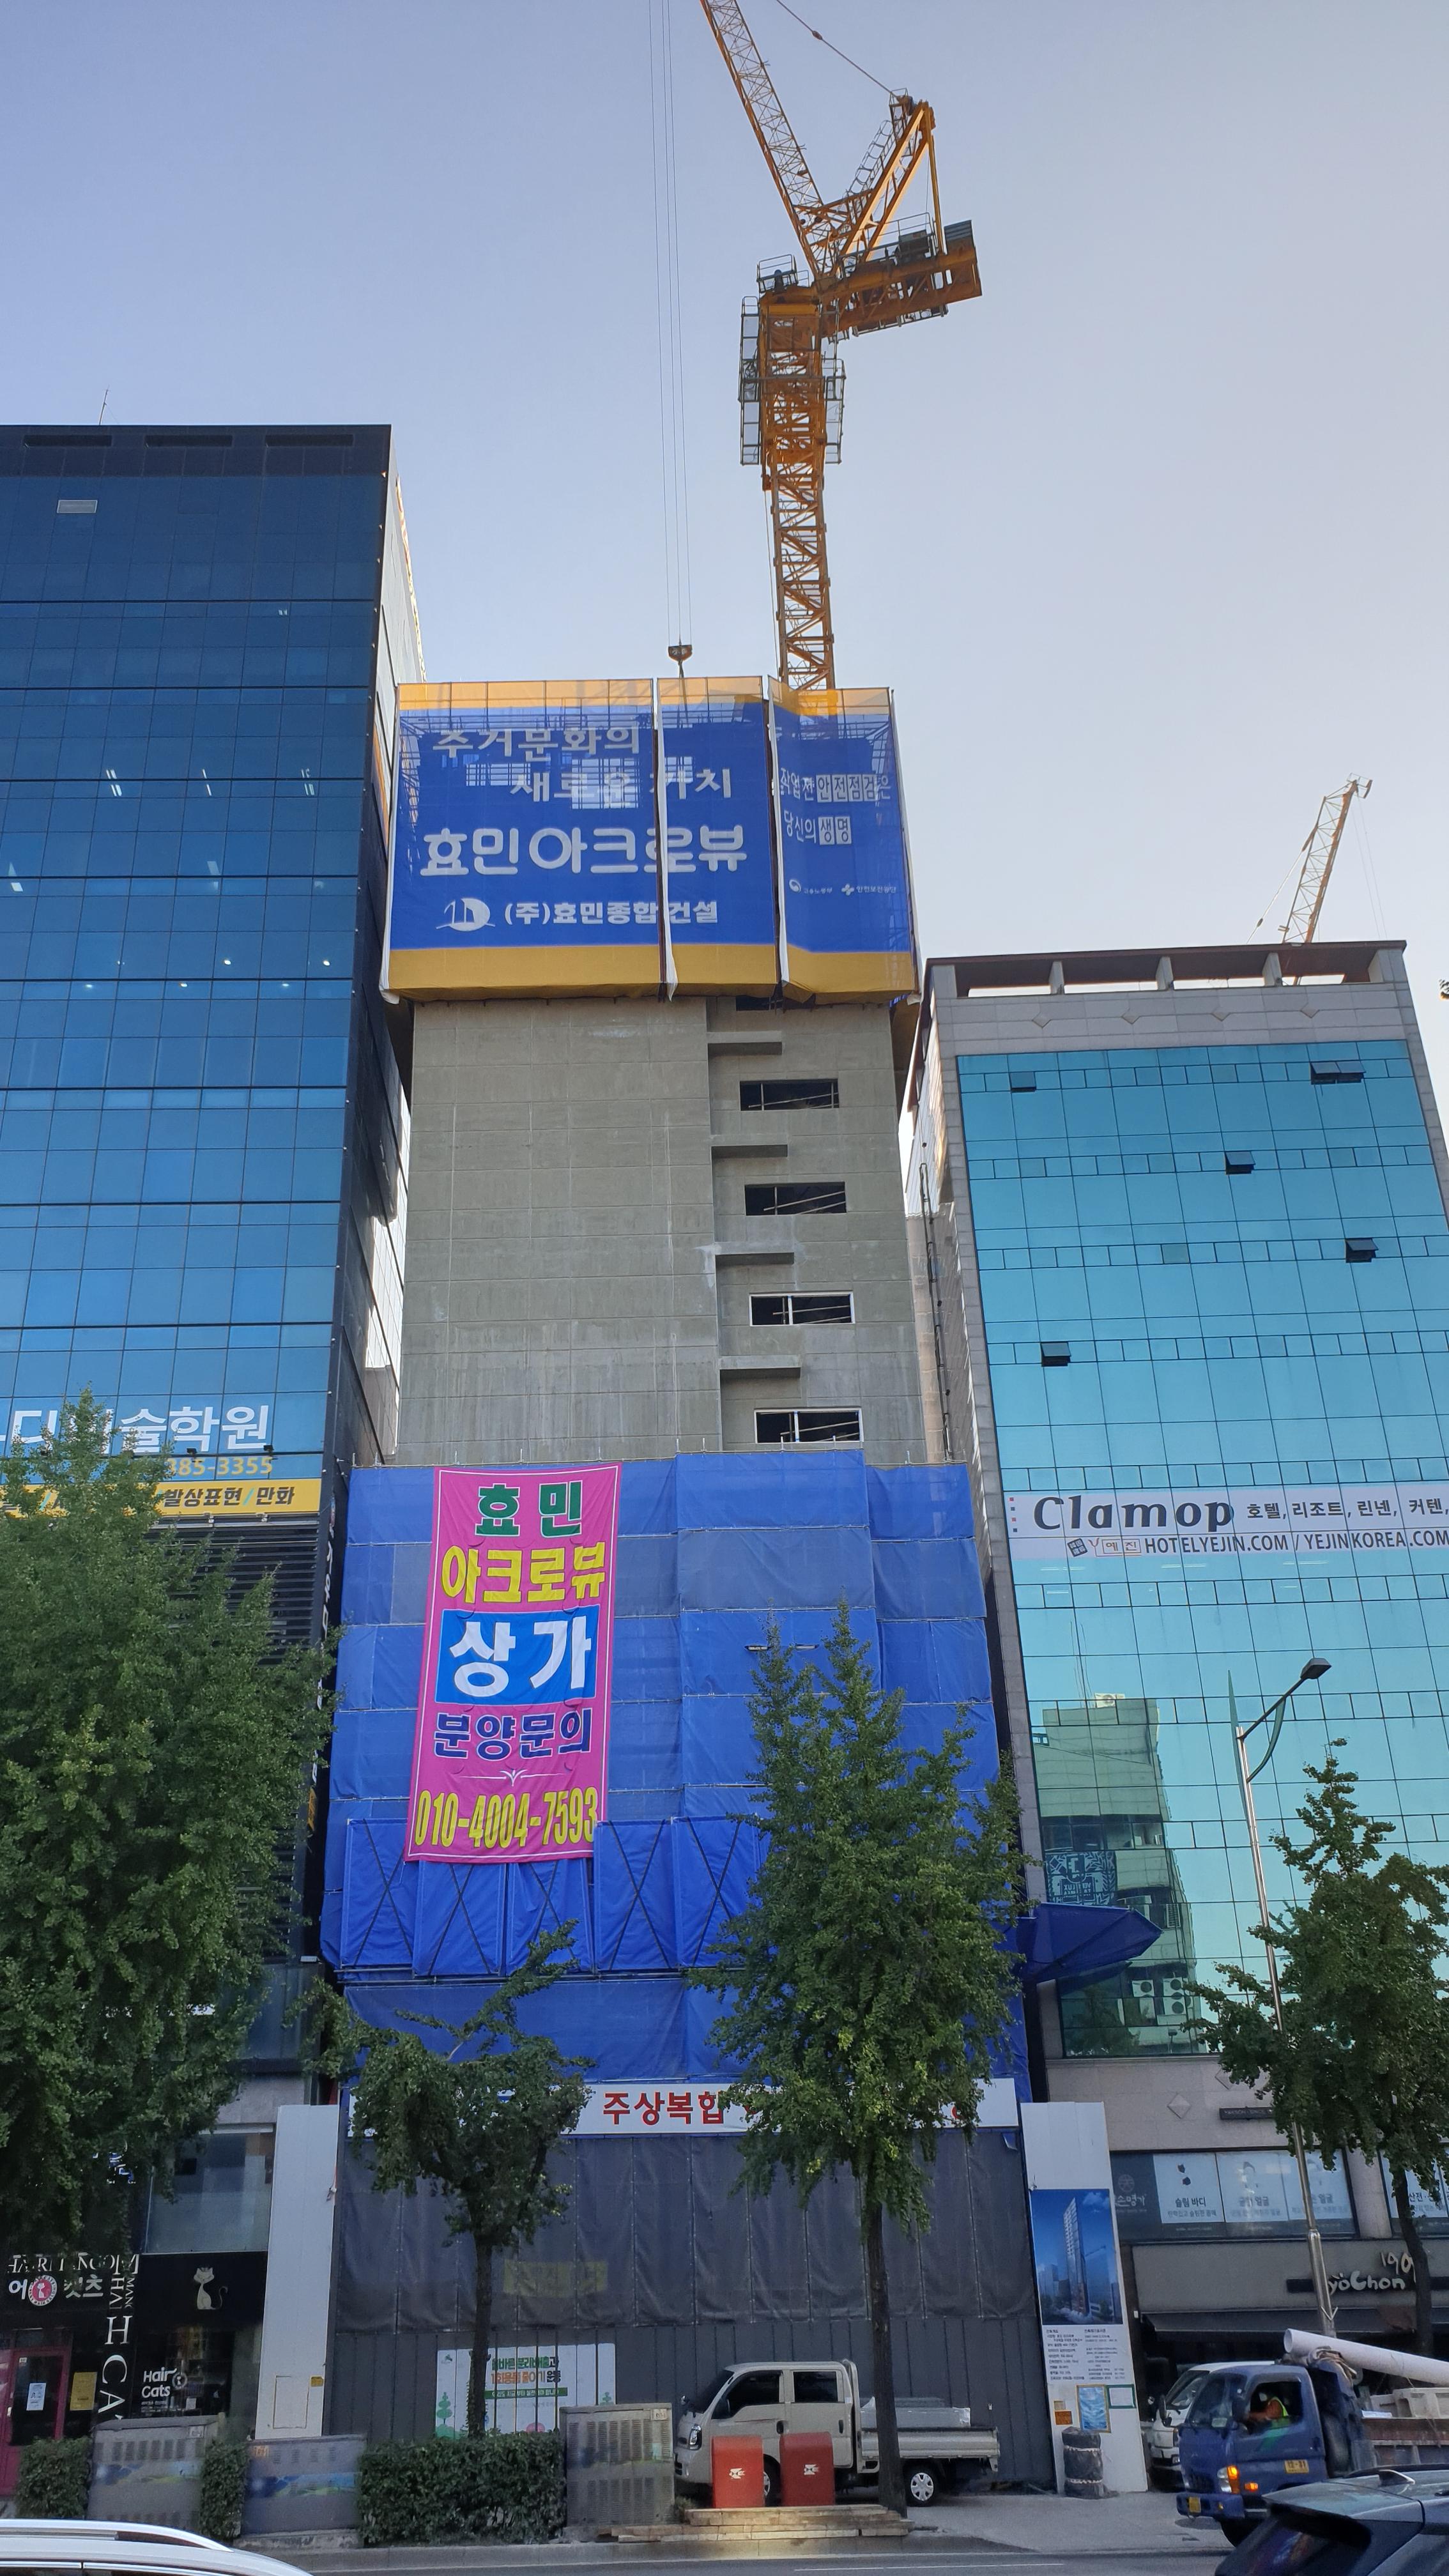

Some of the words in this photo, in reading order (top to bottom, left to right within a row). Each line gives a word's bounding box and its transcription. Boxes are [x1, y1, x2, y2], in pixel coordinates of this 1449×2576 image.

[432, 726, 640, 762] 주거문화의
[784, 809, 816, 843] 당신의
[818, 816, 852, 845] 생명
[420, 827, 519, 876] 효민
[528, 824, 747, 874] 아크로뷰
[474, 1479, 583, 1538] 효민
[1034, 1494, 1234, 1532] Clamop
[1247, 1503, 1287, 1519] 호텔,
[1292, 1501, 1352, 1519] 리조트,
[1357, 1499, 1398, 1517] 린넨,
[1409, 1498, 1449, 1515] 커텐,
[1144, 1535, 1289, 1554] HOTELYEJIN.COM
[1304, 1530, 1449, 1549] YEJINKOREA.COM
[441, 1541, 606, 1604] 아크로뷰
[449, 1615, 592, 1698] 상가
[434, 1707, 593, 1761] 분양문의
[414, 1786, 599, 1848] 010-4004-7593
[603, 2091, 724, 2126] 주상복합
[1114, 2194, 1146, 2207] 손명가
[1192, 2196, 1206, 2207] 바디
[142, 2384, 171, 2398] Cats
[143, 2366, 178, 2382] Hair
